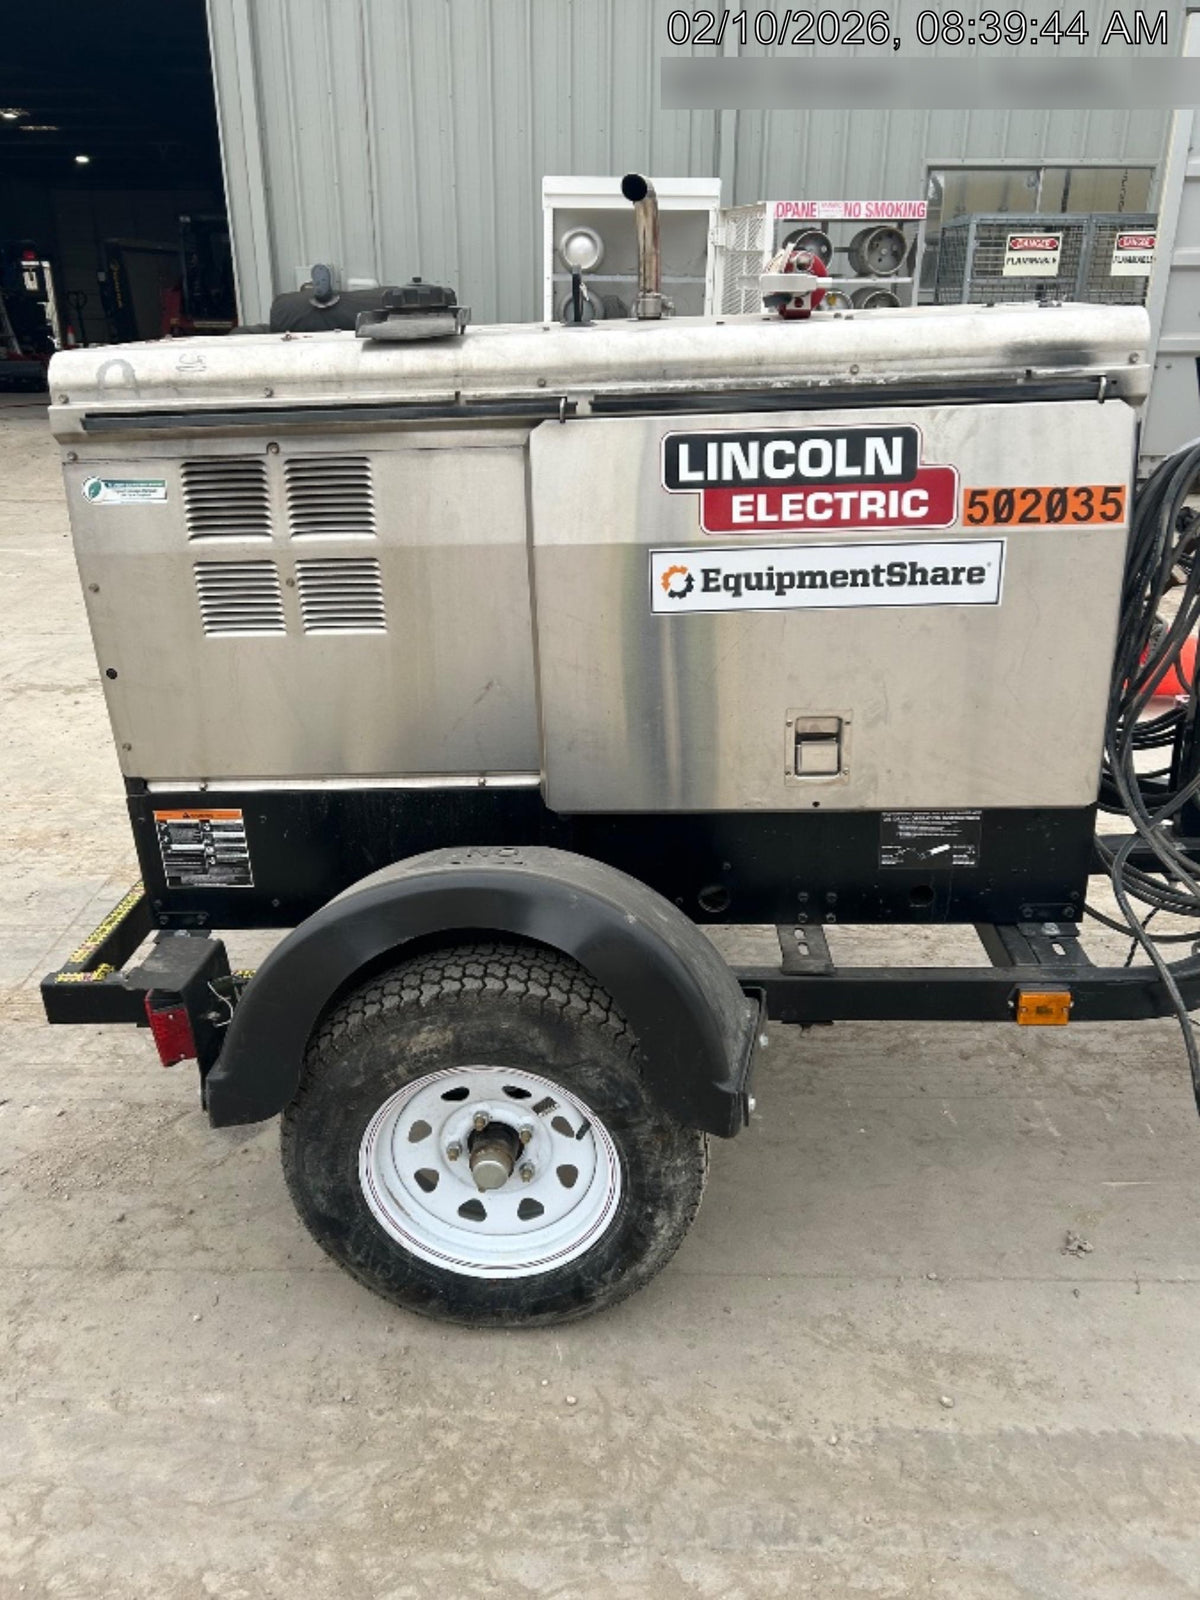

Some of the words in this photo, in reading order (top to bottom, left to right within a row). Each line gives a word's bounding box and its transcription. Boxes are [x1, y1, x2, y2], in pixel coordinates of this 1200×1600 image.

[843, 202, 862, 218] NO
[865, 202, 926, 218] SMOKING
[677, 436, 904, 482] LINCOLN
[731, 489, 930, 523] ELECTRIC
[966, 486, 1124, 525] 502035
[700, 561, 987, 600] EquipmentShare
